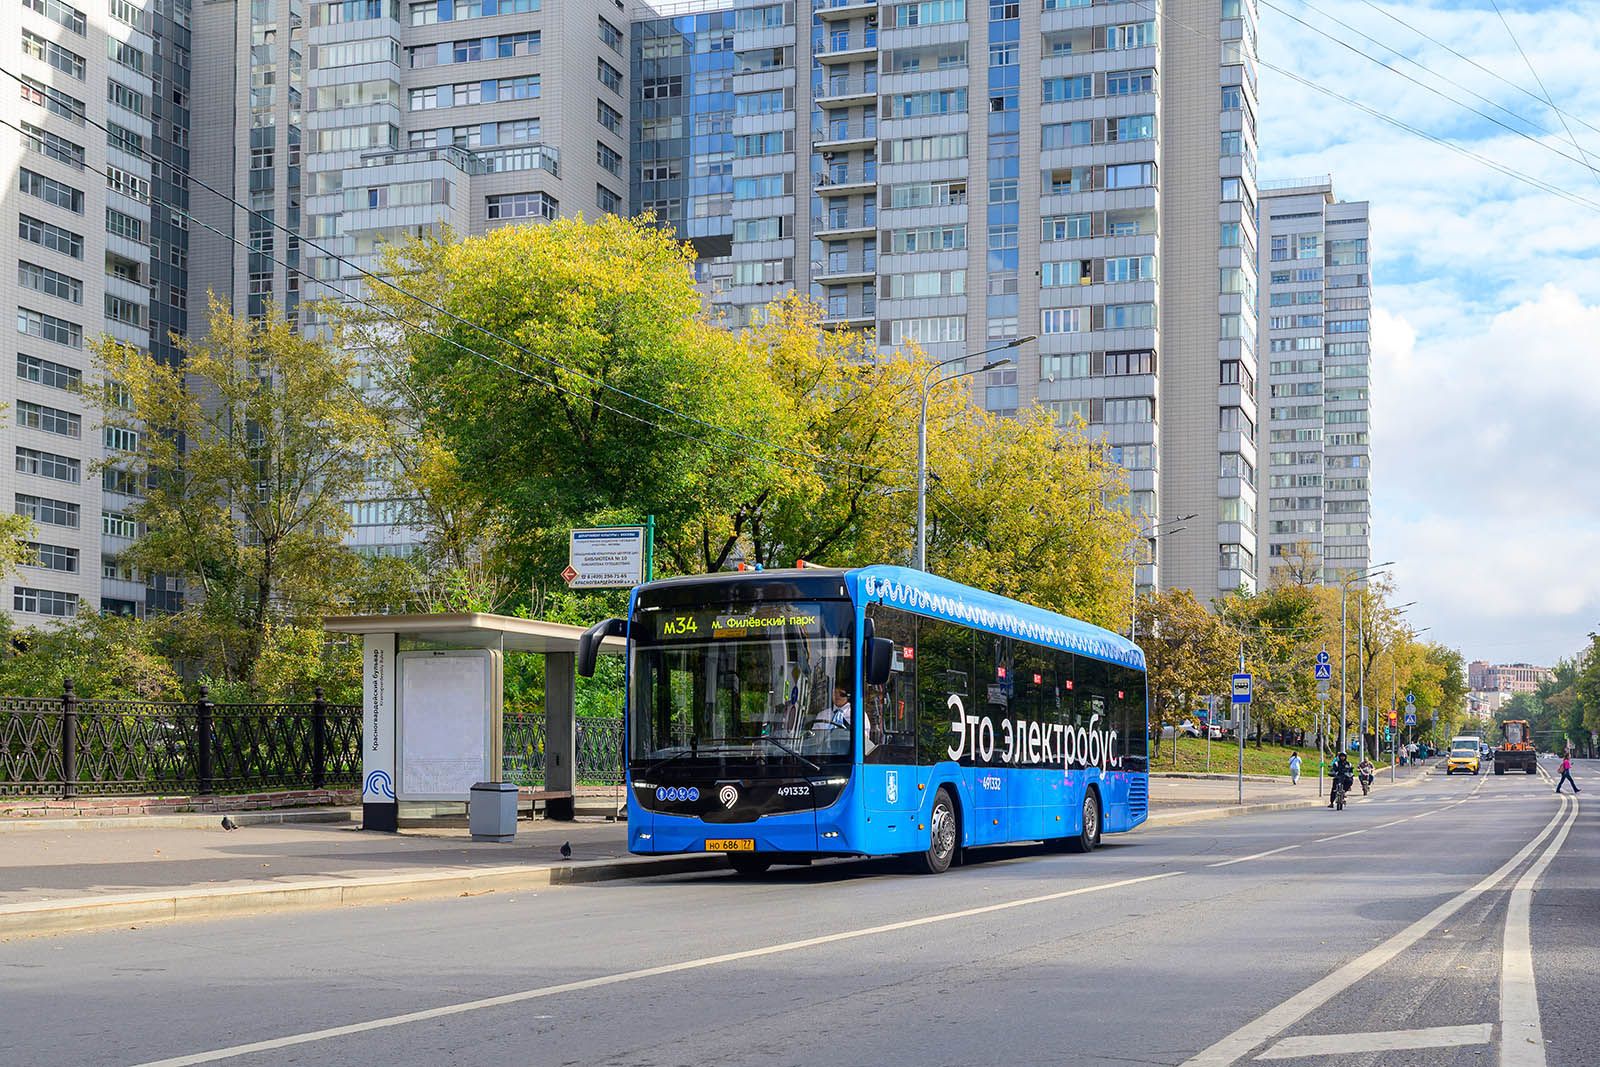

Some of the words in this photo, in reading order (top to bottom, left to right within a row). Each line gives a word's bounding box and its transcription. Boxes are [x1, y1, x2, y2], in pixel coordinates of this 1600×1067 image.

[727, 615, 786, 628] Филёвский
[789, 615, 815, 627] парк
[947, 694, 994, 763] Это
[1001, 714, 1122, 779] электробус.
[983, 776, 1001, 790] 491332
[777, 786, 810, 796] 491332
[723, 840, 738, 849] 686
